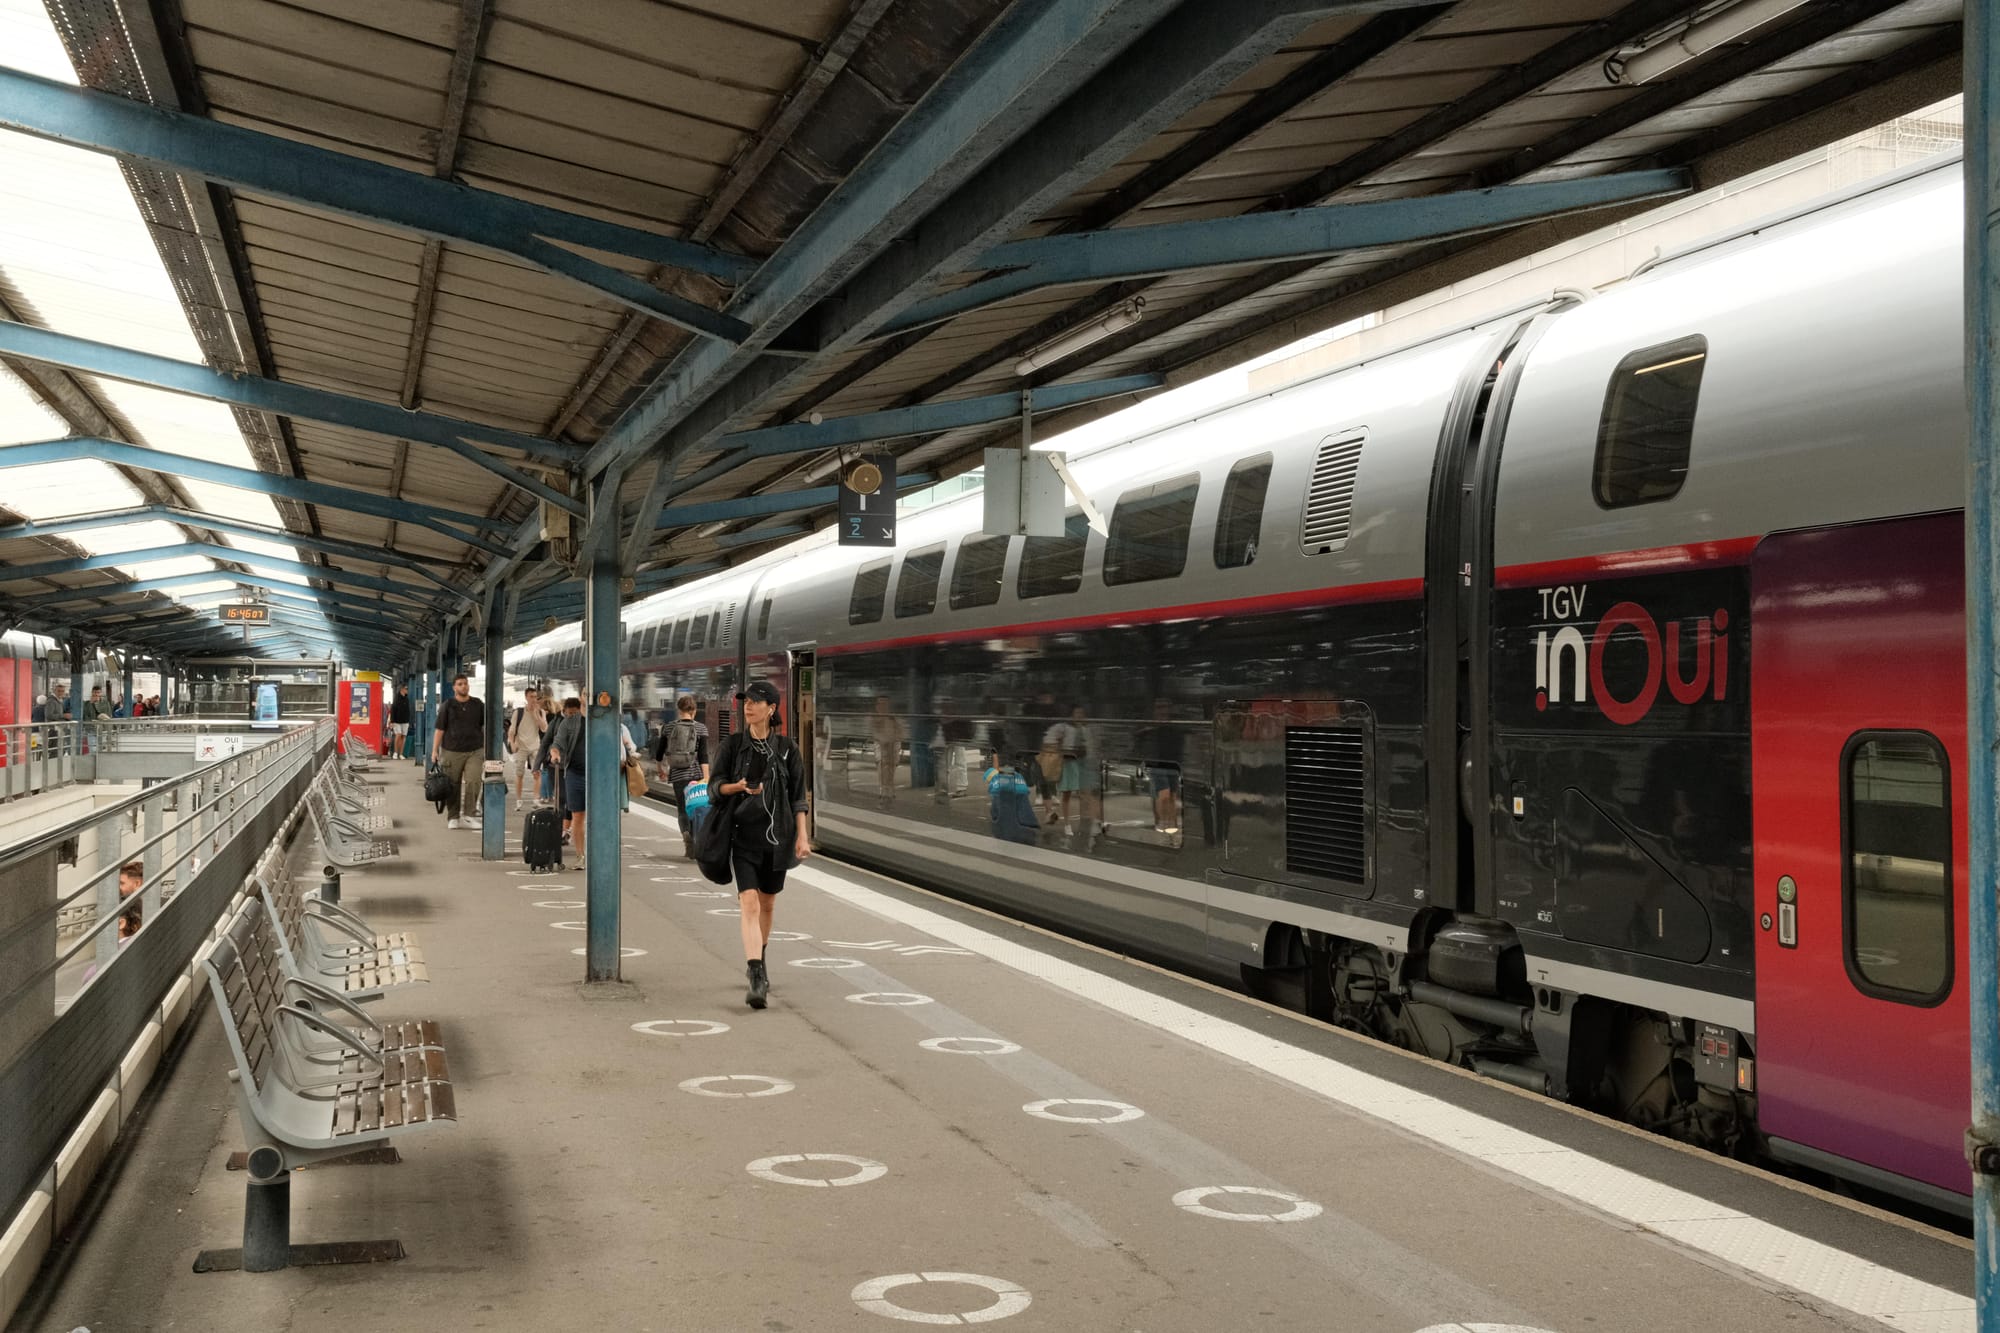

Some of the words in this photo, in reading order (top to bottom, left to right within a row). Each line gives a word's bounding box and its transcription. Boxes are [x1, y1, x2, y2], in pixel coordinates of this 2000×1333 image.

[851, 523, 861, 536] 2
[1538, 585, 1587, 620] TGV
[224, 736, 239, 744] OUI
